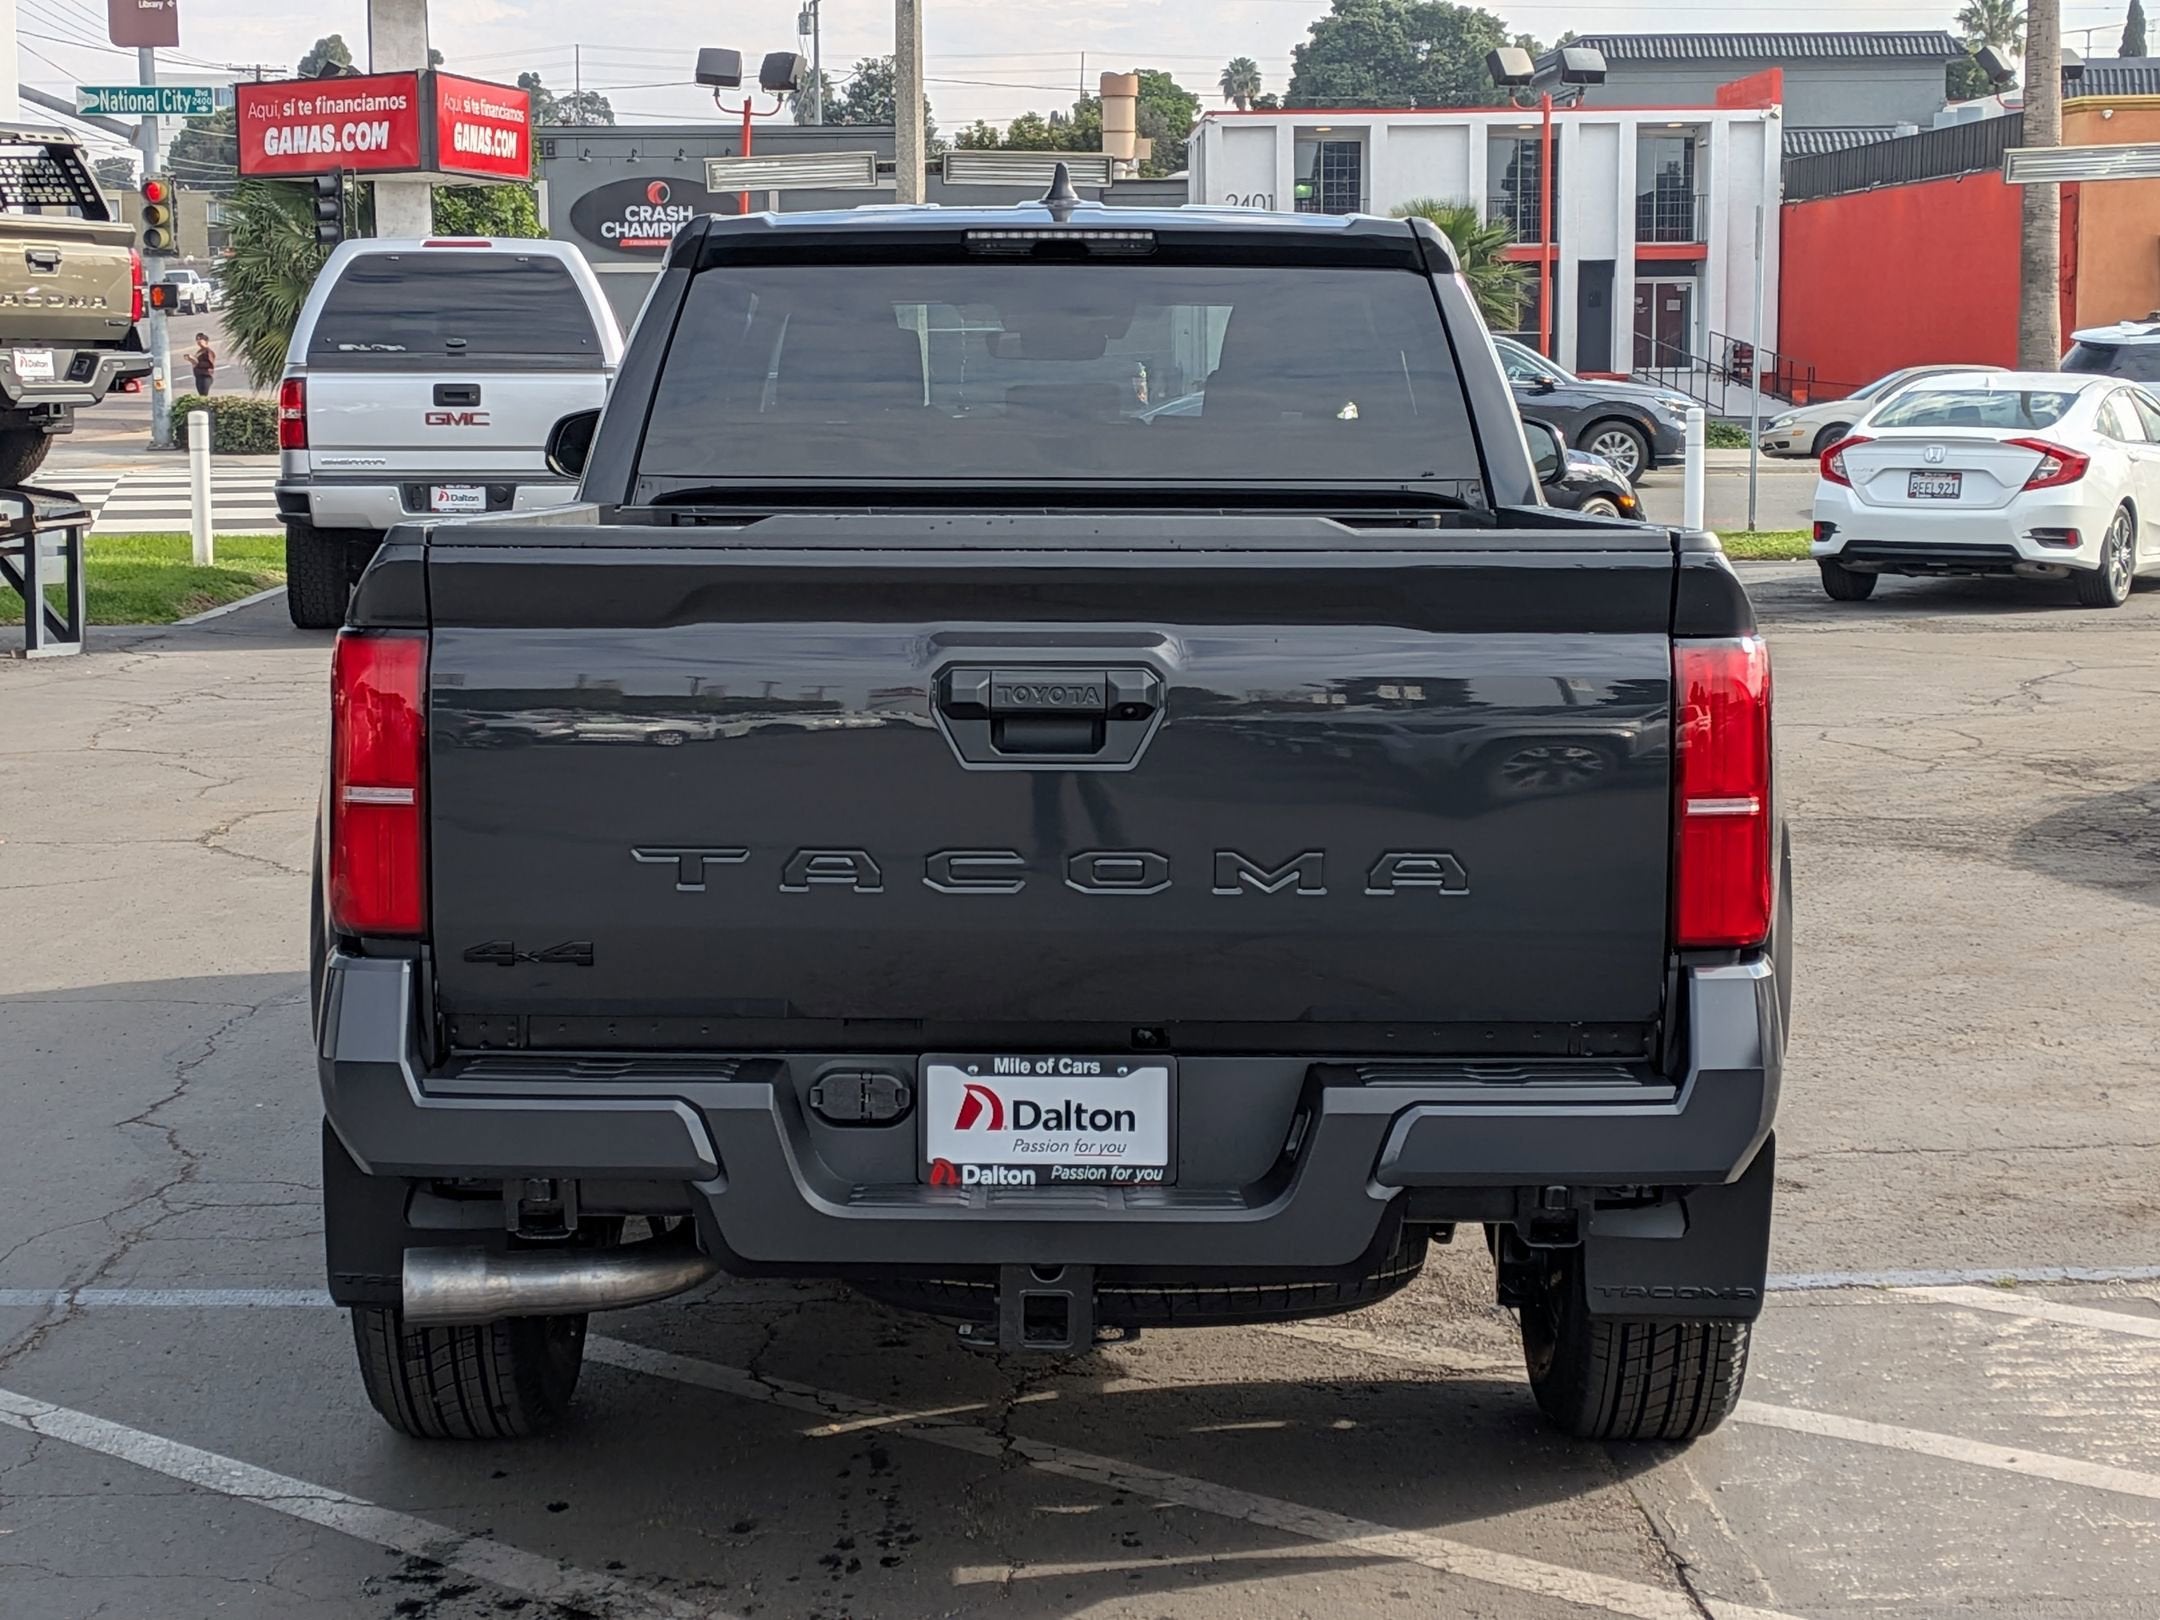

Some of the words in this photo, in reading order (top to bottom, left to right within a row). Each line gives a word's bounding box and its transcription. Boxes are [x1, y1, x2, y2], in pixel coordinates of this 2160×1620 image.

[100, 89, 158, 112] National
[162, 89, 191, 114] City
[195, 89, 208, 97] Blvd
[283, 98, 296, 116] sí
[298, 99, 313, 116] te
[315, 94, 407, 115] financiamos
[480, 98, 525, 124] financiamos
[264, 120, 390, 156] GANAS.COM
[454, 121, 518, 159] GANAS.COM
[625, 205, 693, 221] CRASH
[424, 411, 491, 427] GMC
[450, 493, 480, 502] Dalton
[996, 684, 1101, 705] TOYOTA
[631, 846, 1470, 896] TACOMA
[994, 1057, 1031, 1074] Mile
[1035, 1057, 1056, 1074] of
[1058, 1058, 1101, 1075] Cars
[1012, 1099, 1136, 1132] Dalton
[1012, 1138, 1069, 1153] Passion
[1073, 1138, 1095, 1154] for
[1098, 1141, 1127, 1155] you
[962, 1164, 1036, 1185] Dalton
[1051, 1165, 1106, 1181] Passion
[1109, 1166, 1131, 1182] for
[1134, 1168, 1164, 1183] you
